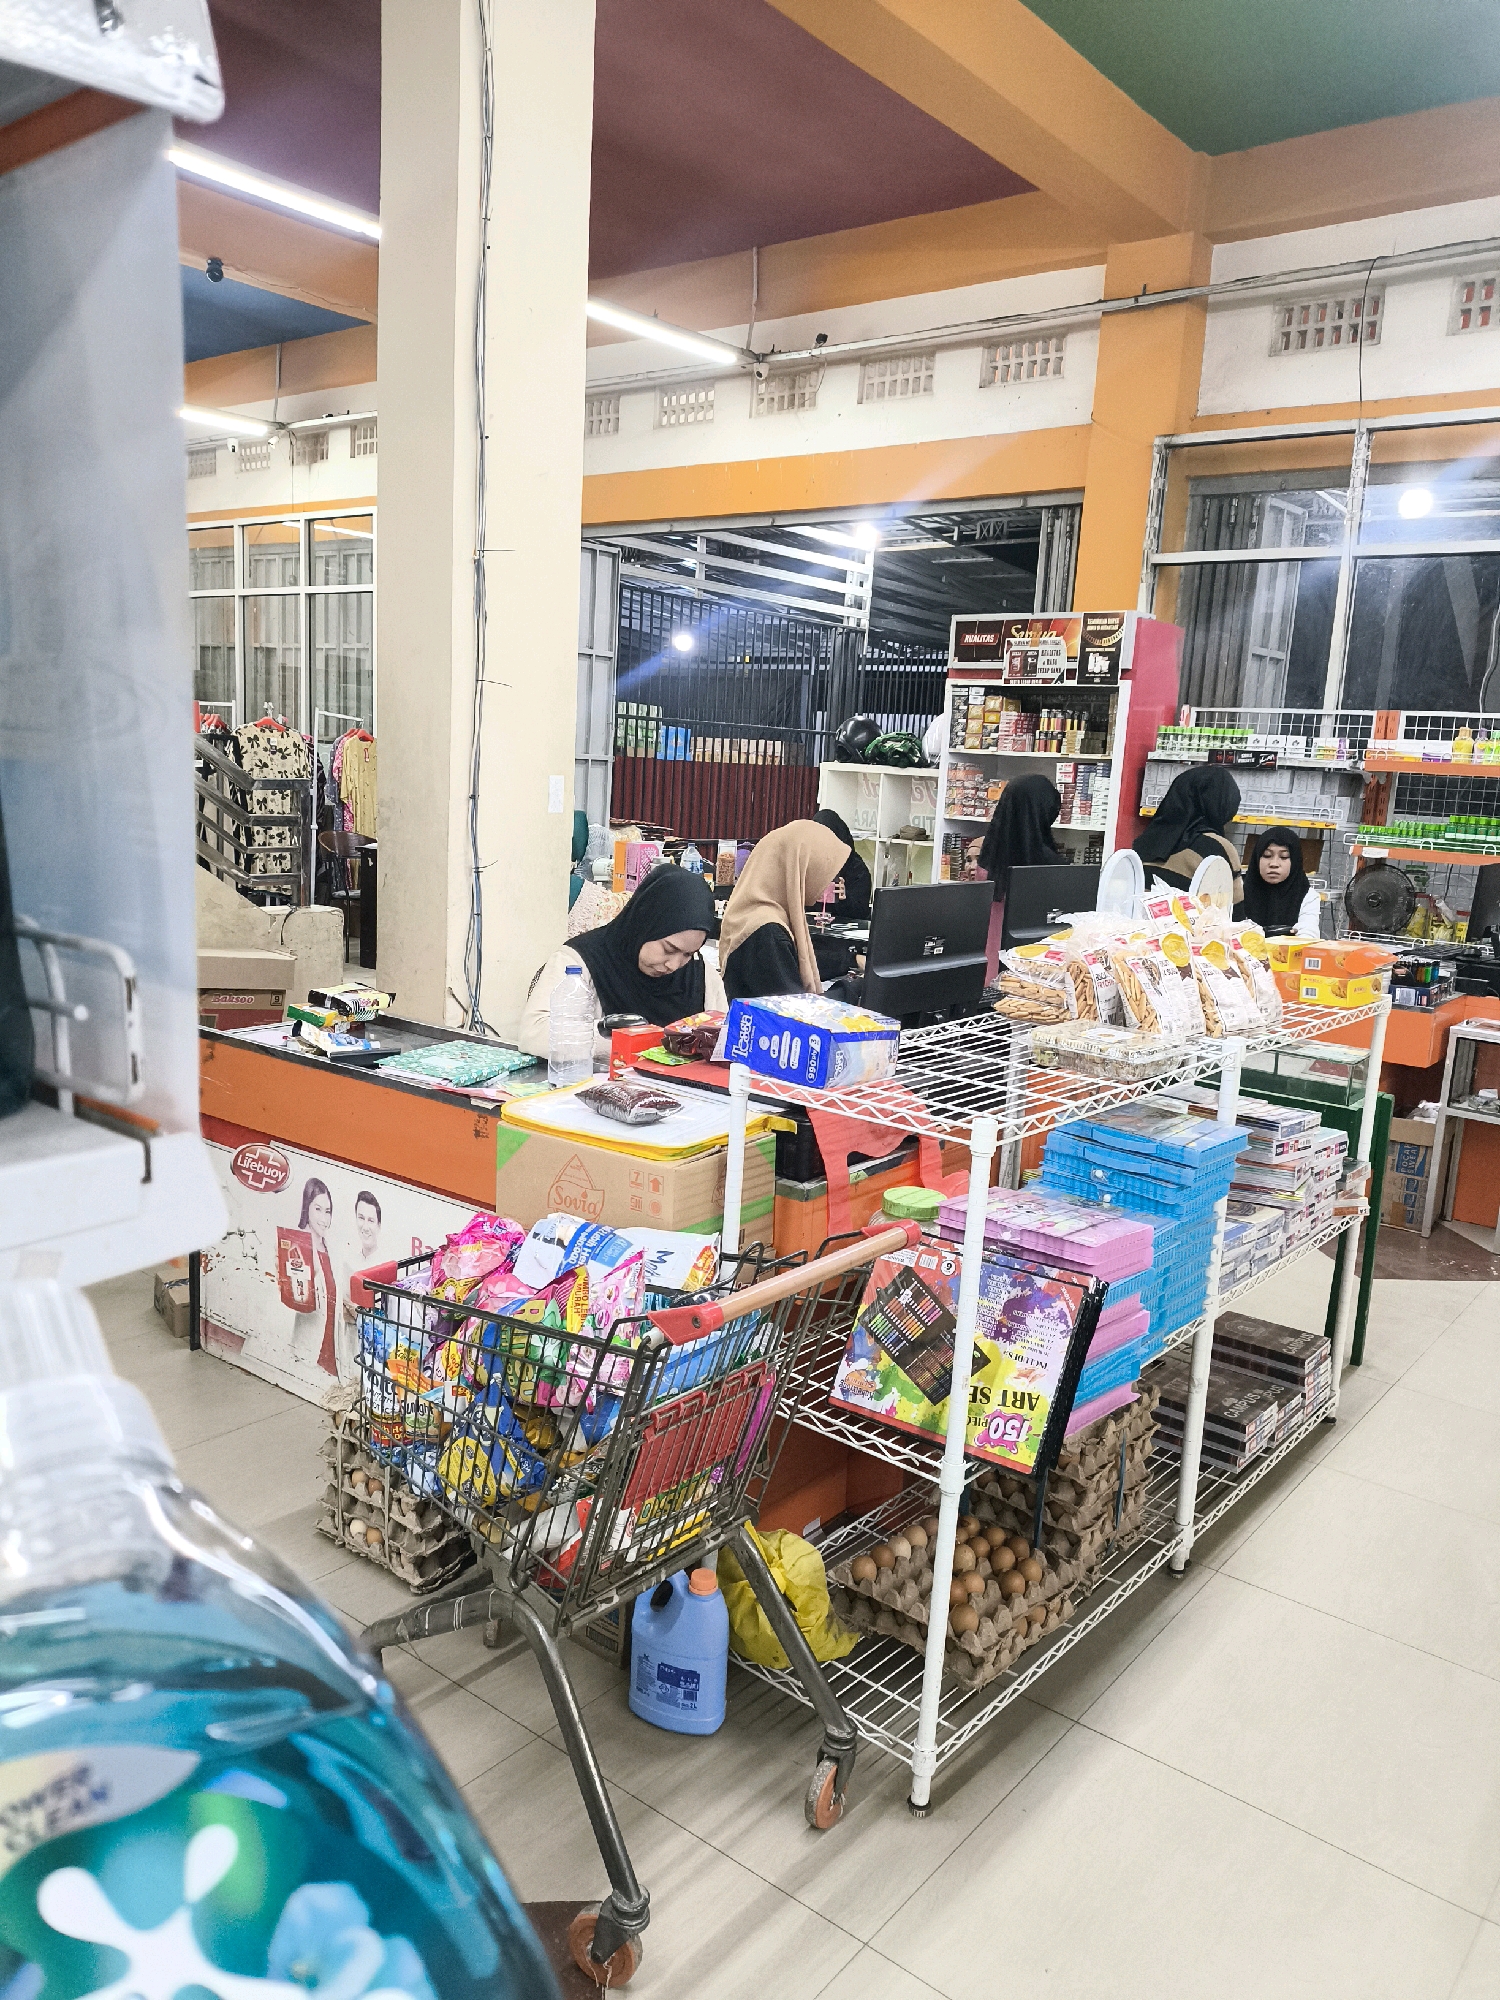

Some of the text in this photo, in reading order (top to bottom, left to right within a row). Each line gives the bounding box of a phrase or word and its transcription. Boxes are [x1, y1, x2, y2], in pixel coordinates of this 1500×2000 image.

[963, 633, 996, 644] KUALITAS
[237, 1154, 286, 1182] Lifebuoy
[554, 1185, 599, 1217] Sovia
[1283, 1332, 1315, 1355] CAMPUS
[968, 1385, 1041, 1412] ART SE
[1223, 1392, 1261, 1419] CAMPUS
[988, 1415, 1030, 1443] 150
